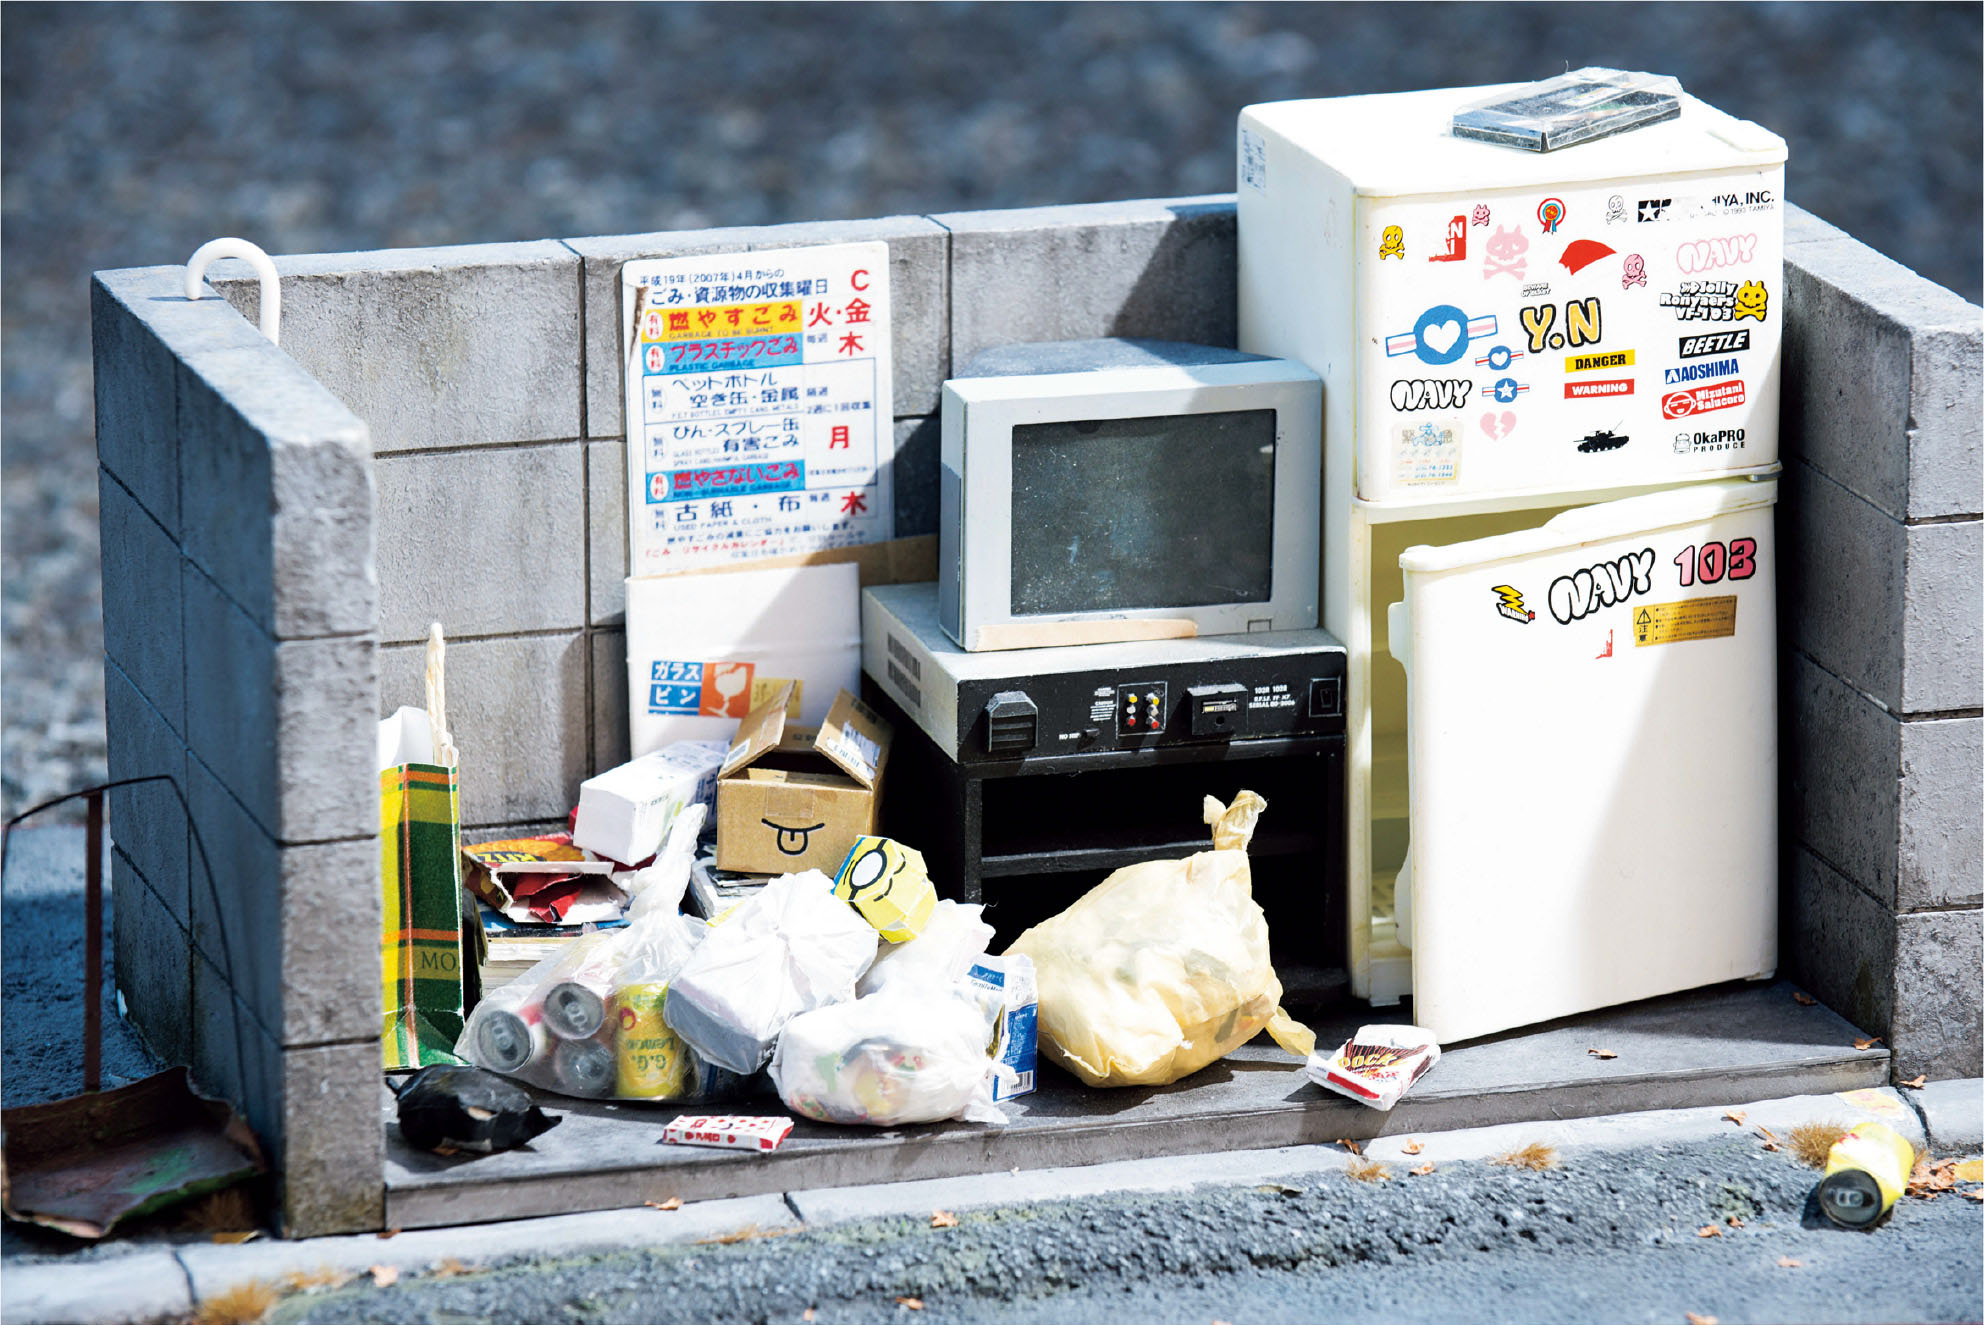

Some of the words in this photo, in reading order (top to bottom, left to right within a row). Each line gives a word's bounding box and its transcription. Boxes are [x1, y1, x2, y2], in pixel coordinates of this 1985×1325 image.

[1746, 190, 1774, 205] INC.
[1676, 233, 1757, 275] NAVY
[651, 278, 829, 305] ごみ・資源物の収集曜日
[850, 269, 870, 292] C
[669, 304, 798, 331] 燃やすごみ
[808, 297, 872, 328] 火・金
[1675, 307, 1735, 321] VF-103
[1520, 297, 1601, 353] Y.N
[670, 336, 800, 363] プラスチックごみ
[838, 330, 865, 357] 木
[1681, 332, 1748, 357] BEETLE
[1575, 353, 1627, 370] DANGER
[1681, 358, 1739, 382] AOSHIMA
[671, 372, 779, 392] ペットボトル
[1571, 382, 1627, 396] WARNING
[689, 386, 800, 409] 空き缶・金属
[1390, 379, 1473, 411] NAVY
[673, 417, 800, 440] びん・スプレー缶
[829, 425, 849, 450] 月
[1693, 429, 1746, 446] OkaPRO
[1693, 440, 1746, 453] PRODUCE
[673, 463, 800, 490] 燃やさないごみ
[675, 495, 801, 522] 古紙・布
[840, 491, 868, 517] 木
[1547, 547, 1655, 625] NAVY
[1673, 537, 1757, 587] 103
[654, 662, 700, 680] ガラス
[655, 686, 697, 705] ビン
[421, 951, 457, 972] MO
